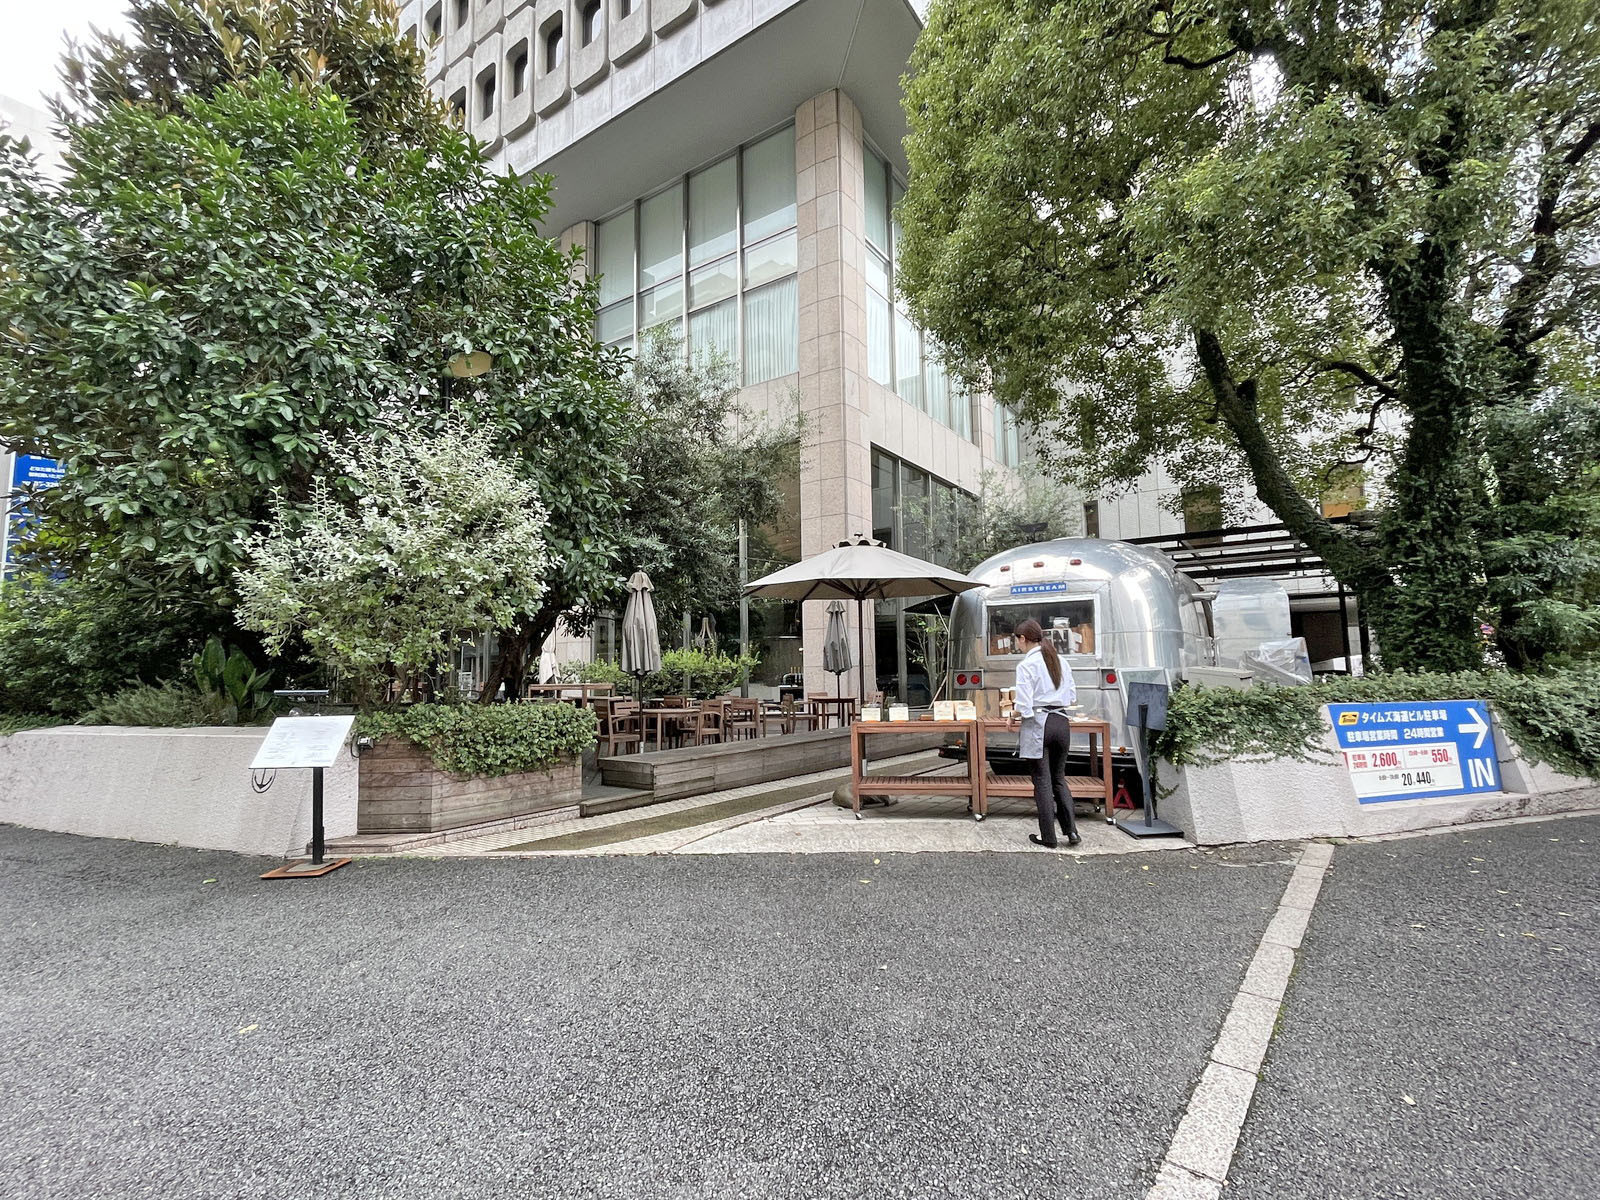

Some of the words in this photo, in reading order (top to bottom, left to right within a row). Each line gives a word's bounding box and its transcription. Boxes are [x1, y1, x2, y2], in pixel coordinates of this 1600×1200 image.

[1011, 584, 1066, 593] AIRSTREAM
[1403, 726, 1445, 740] 24時間営業
[1467, 757, 1496, 788] IN
